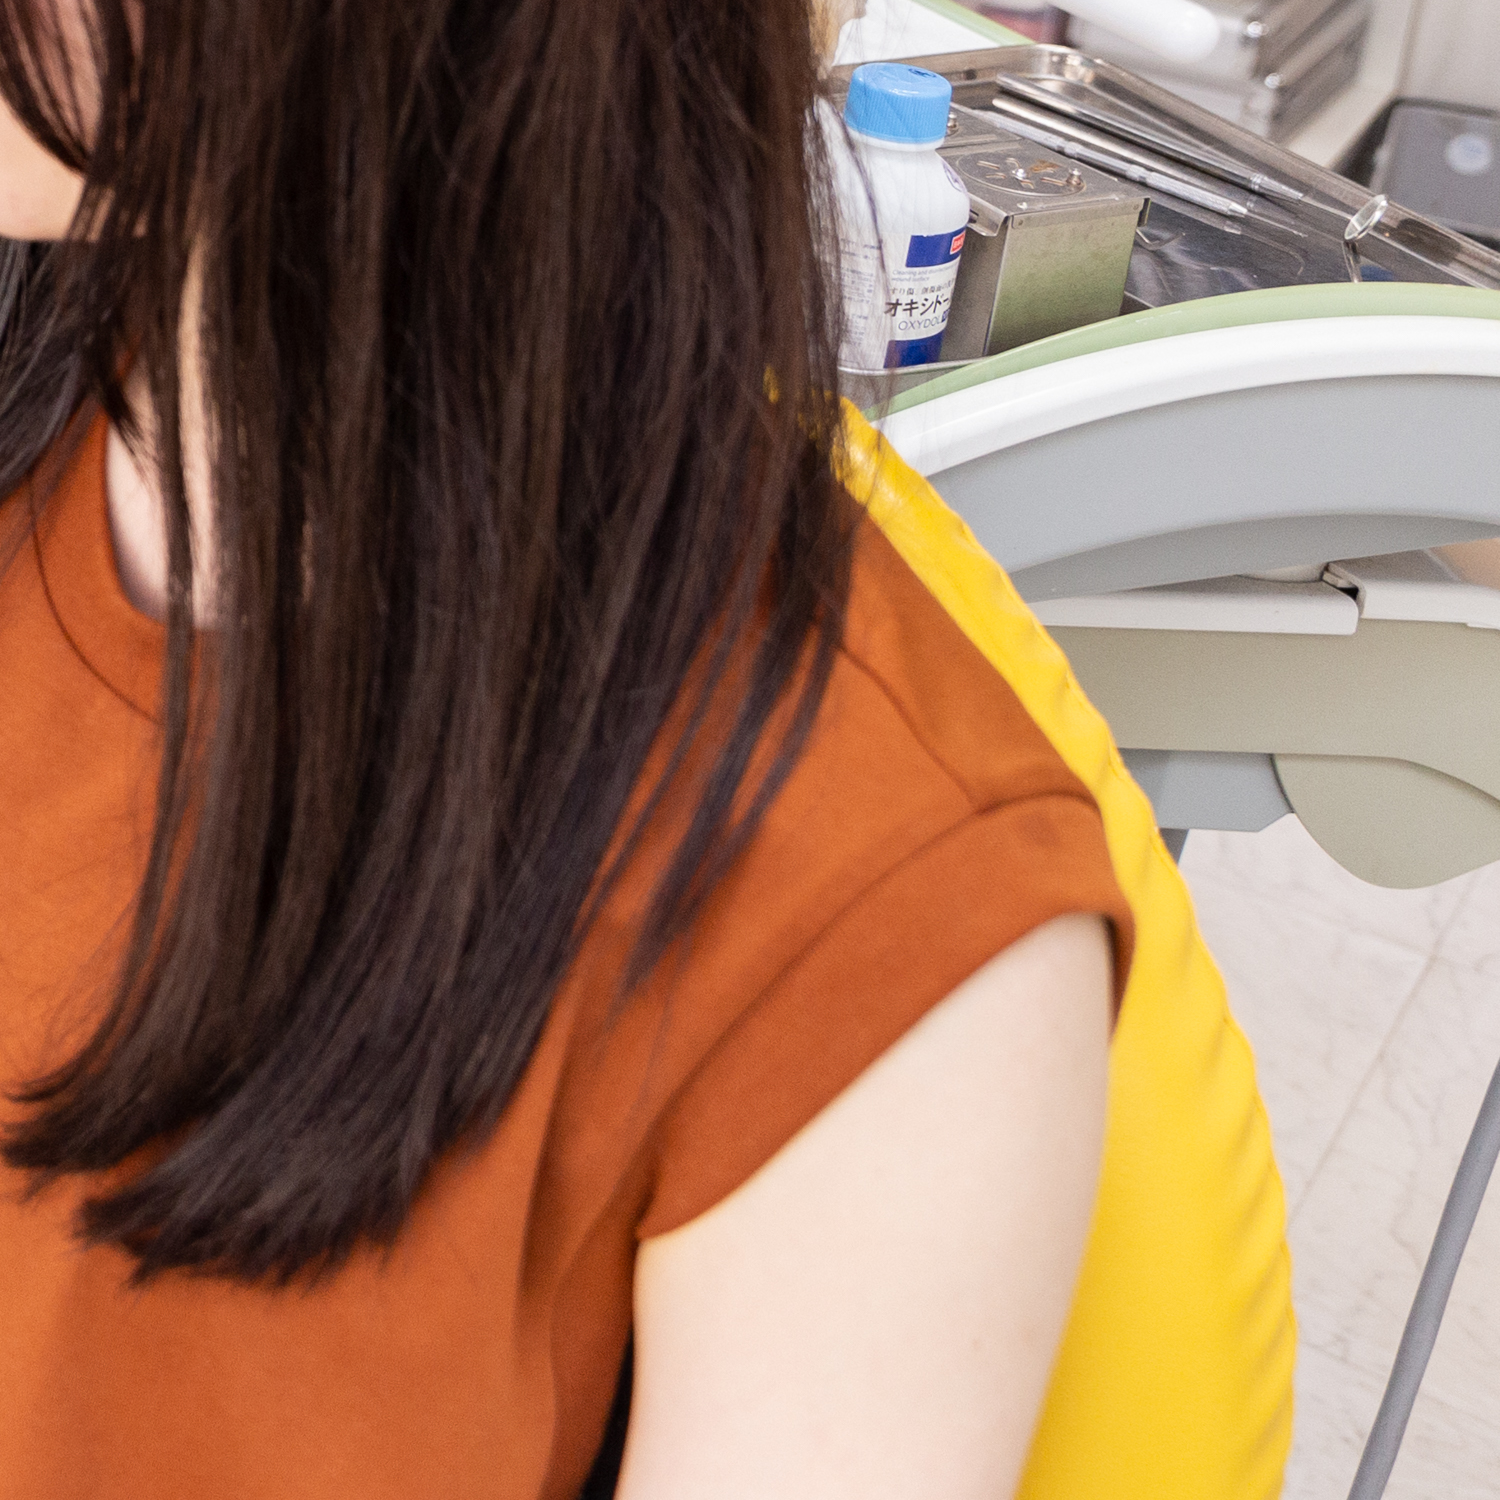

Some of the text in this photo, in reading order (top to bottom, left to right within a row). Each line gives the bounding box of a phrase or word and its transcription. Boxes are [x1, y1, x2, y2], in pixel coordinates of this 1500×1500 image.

[884, 293, 951, 317] オキシドー
